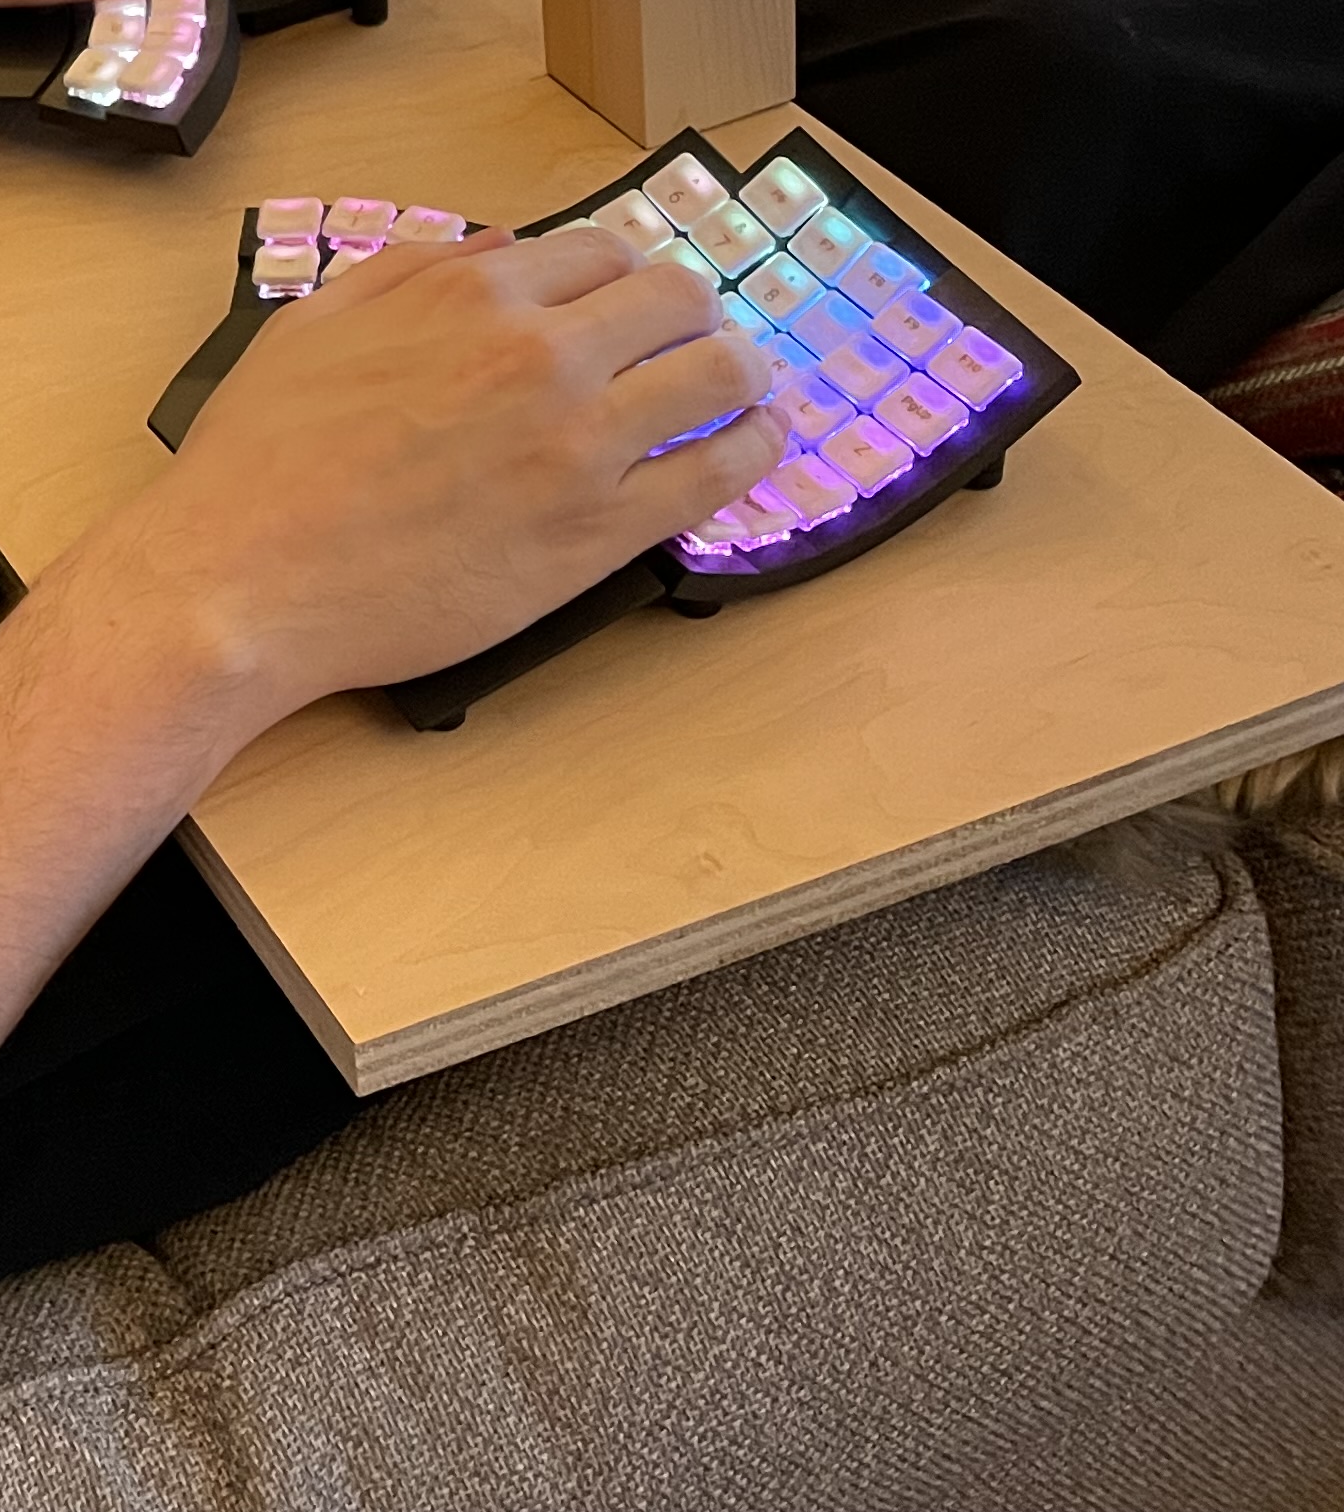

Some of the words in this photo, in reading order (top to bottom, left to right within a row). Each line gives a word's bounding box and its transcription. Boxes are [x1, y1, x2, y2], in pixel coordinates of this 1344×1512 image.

[669, 191, 684, 204] 6
[714, 235, 731, 248] 7
[764, 289, 779, 302] 8
[722, 319, 738, 332] C
[772, 358, 789, 371] R
